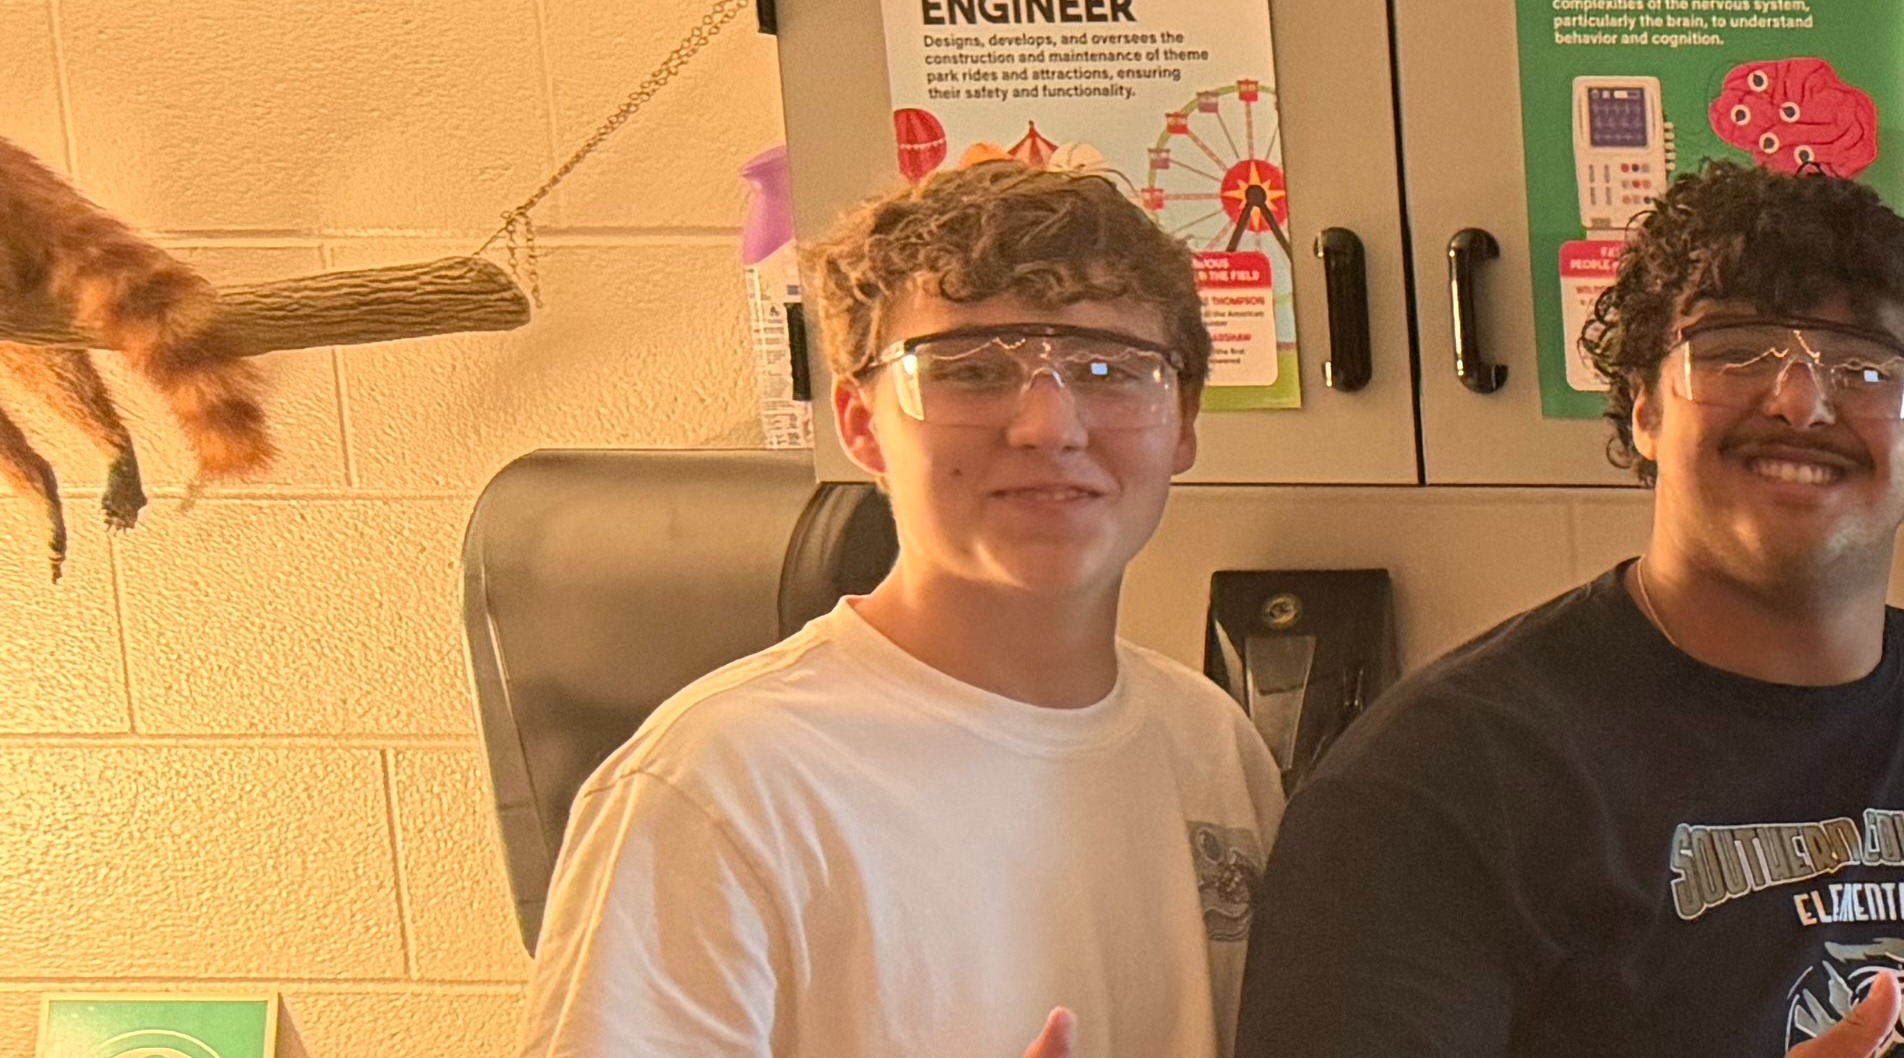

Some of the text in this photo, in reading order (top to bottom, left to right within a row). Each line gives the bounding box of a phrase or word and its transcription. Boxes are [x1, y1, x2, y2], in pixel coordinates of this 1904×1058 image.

[923, 0, 1137, 26] ENGINEER
[1552, 0, 1810, 13] complexities of the nervous system,
[1554, 15, 1814, 30] particularly the brain, to understand
[923, 31, 1184, 49] Designs, develops, and oversees the
[1554, 32, 1724, 48] behavior and cognition.
[925, 47, 1209, 65] construction and maintenance of theme
[926, 66, 1181, 84] park rides and attractions, ensuring
[928, 84, 1136, 101] their safety and functionality.
[1671, 817, 1861, 921] SOUTHERN
